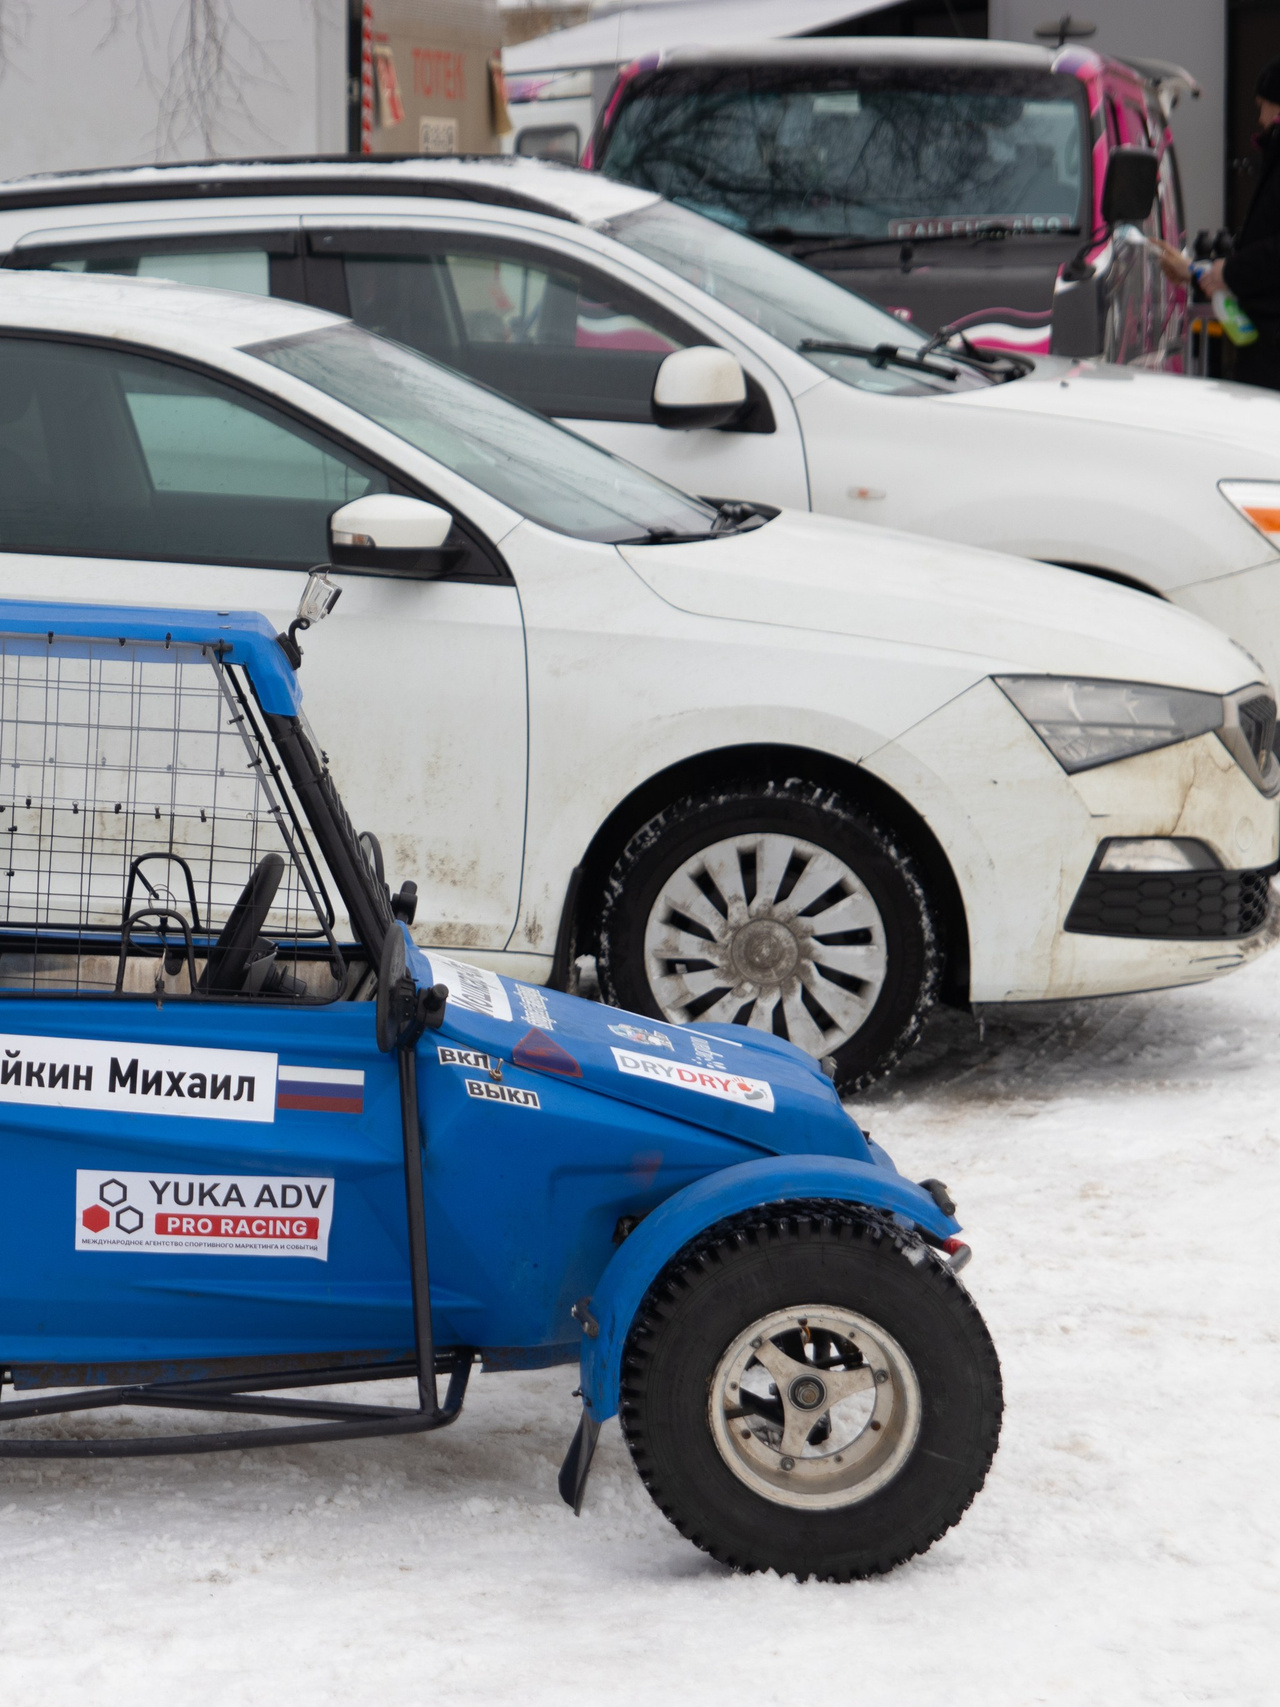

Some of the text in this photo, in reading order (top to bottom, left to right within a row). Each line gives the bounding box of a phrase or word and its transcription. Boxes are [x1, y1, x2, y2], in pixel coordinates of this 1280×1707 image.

[439, 1047, 489, 1069] ВКЛ
[108, 1057, 256, 1102] Михаил
[467, 1080, 538, 1107] ВЫКЛ
[148, 1180, 327, 1209] YUKA ADV
[167, 1217, 308, 1236] PRO RACING
[81, 1238, 143, 1246] МЕЖДУНАРОДНОЕ
[184, 1241, 234, 1249] СПОРТИВНОГО
